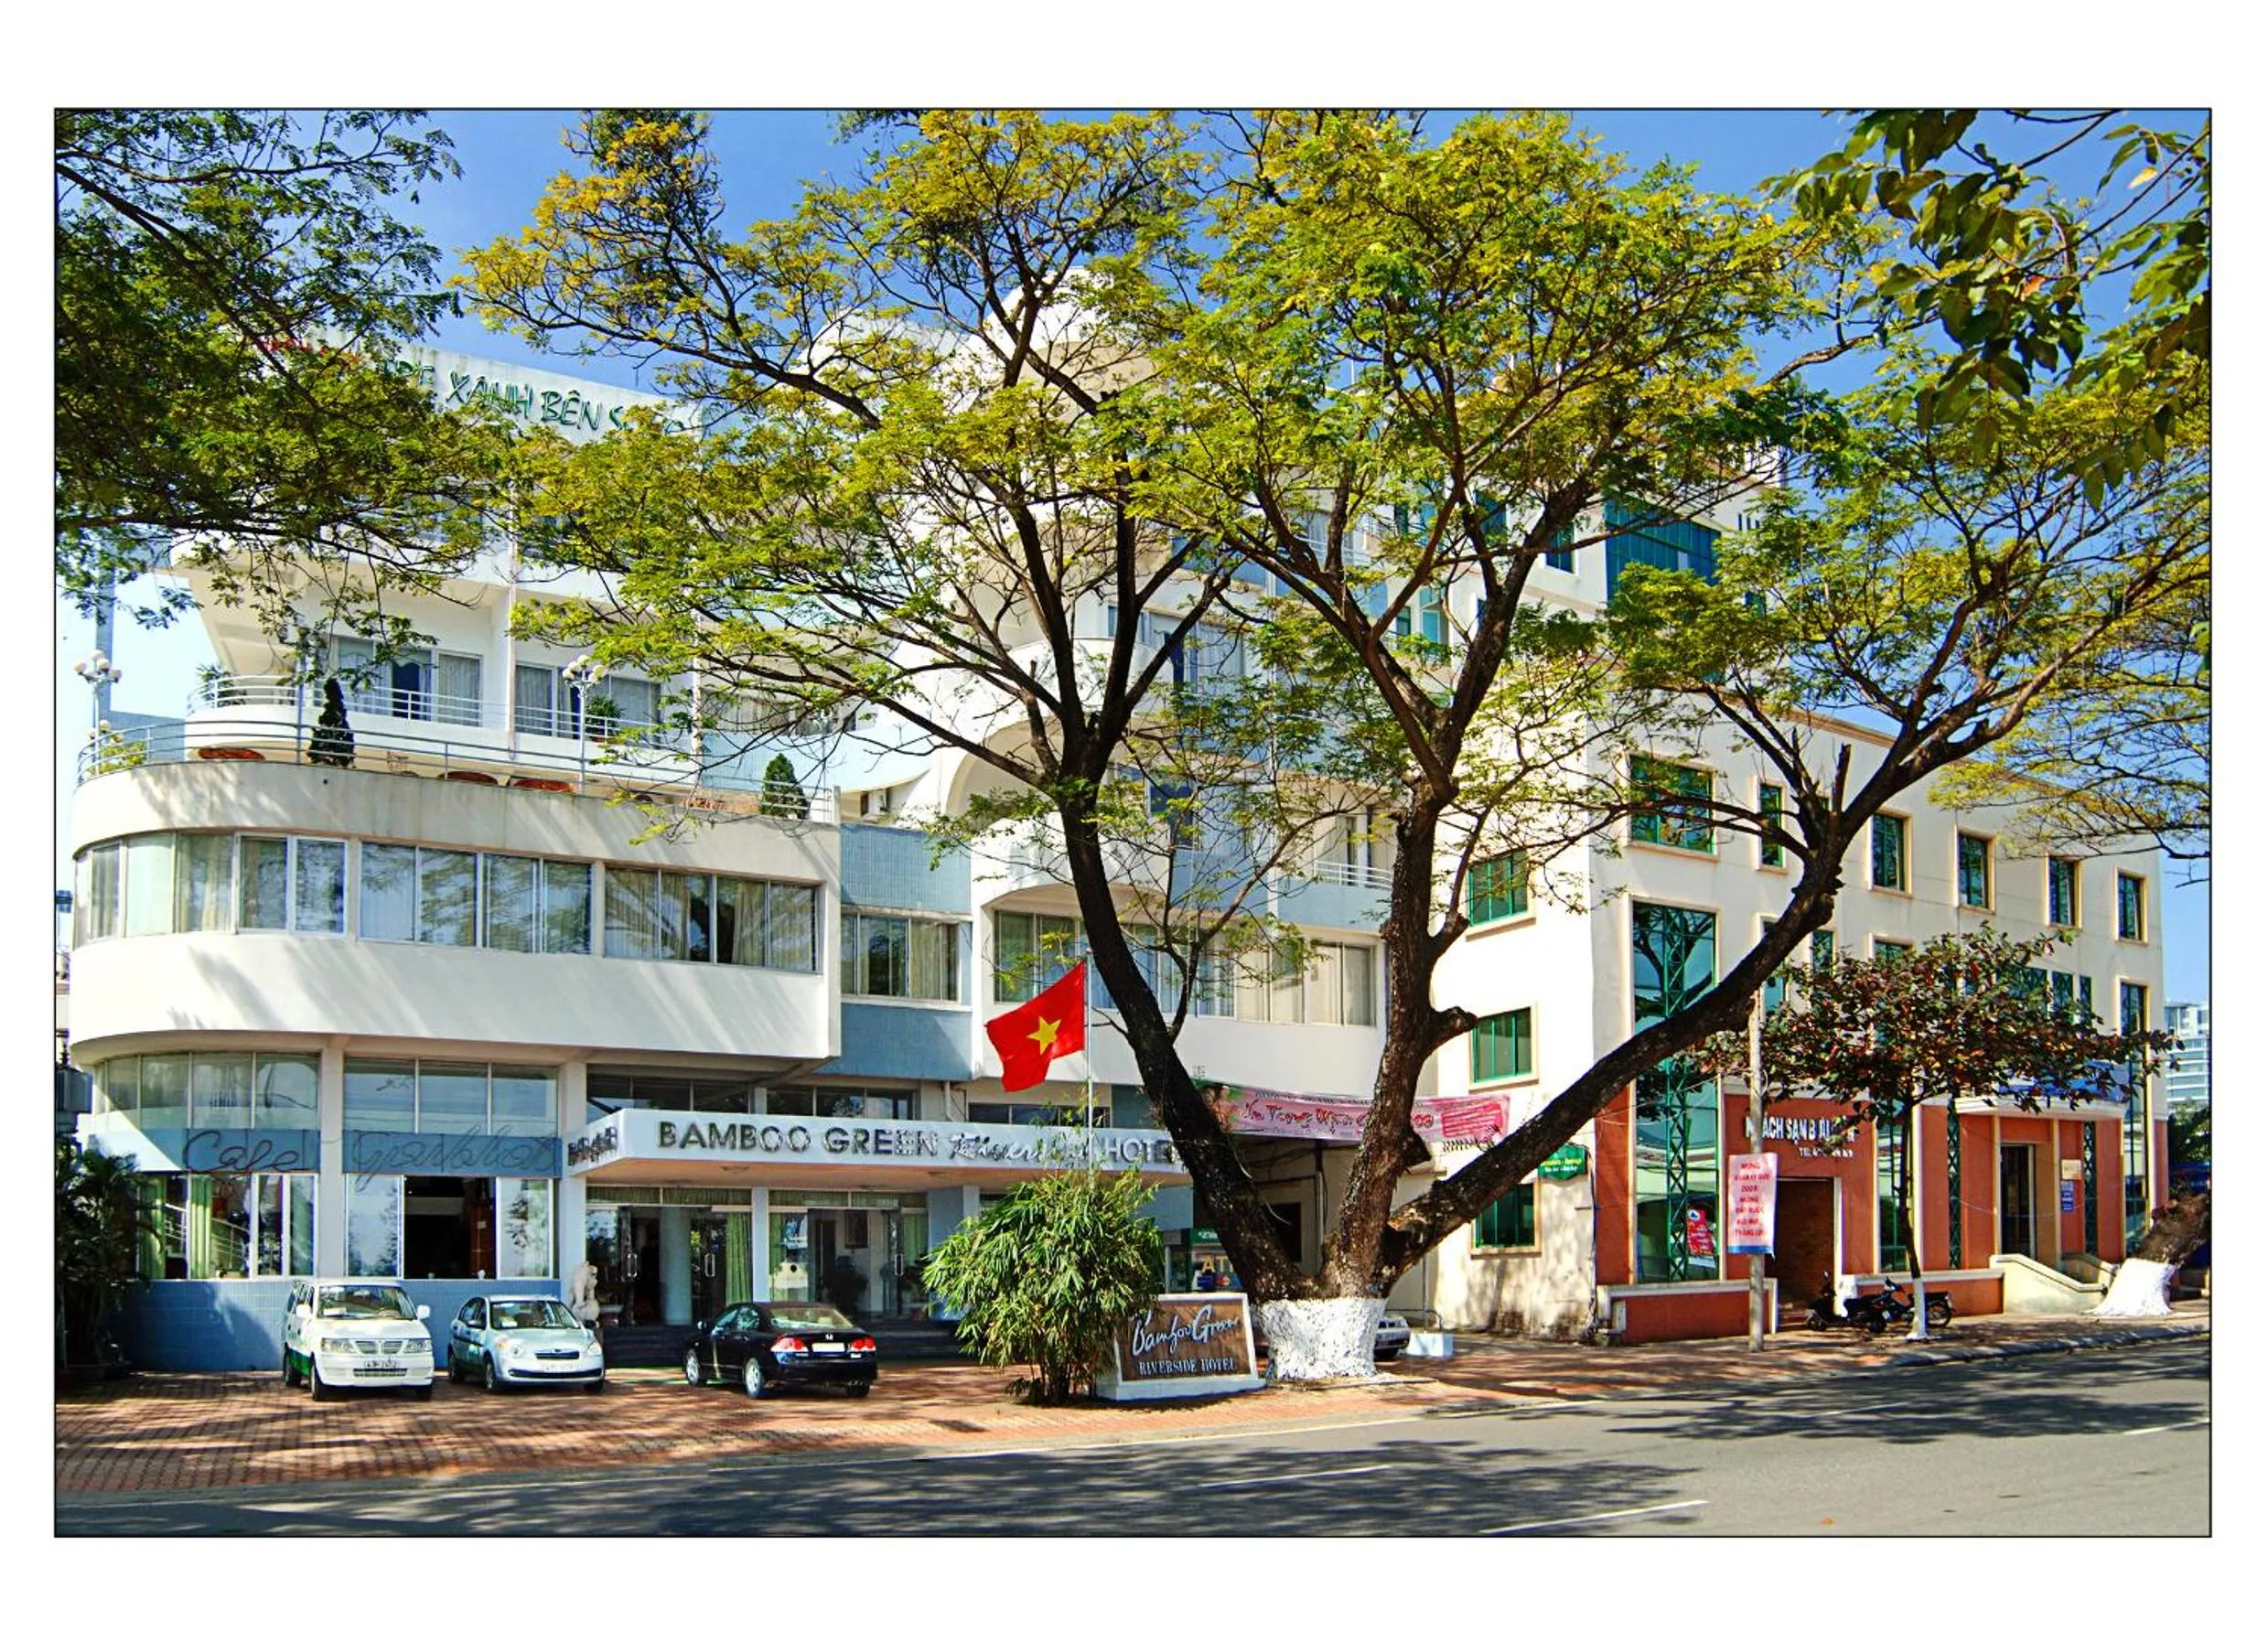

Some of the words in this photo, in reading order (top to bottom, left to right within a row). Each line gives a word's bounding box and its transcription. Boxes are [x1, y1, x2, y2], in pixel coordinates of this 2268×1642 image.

[542, 389, 604, 431] BÊN
[658, 1121, 812, 1154] BAMBOO
[823, 1125, 938, 1158] GREEN
[1138, 1358, 1197, 1376] RIVERSIDE
[1201, 1358, 1236, 1372] HOTEL
